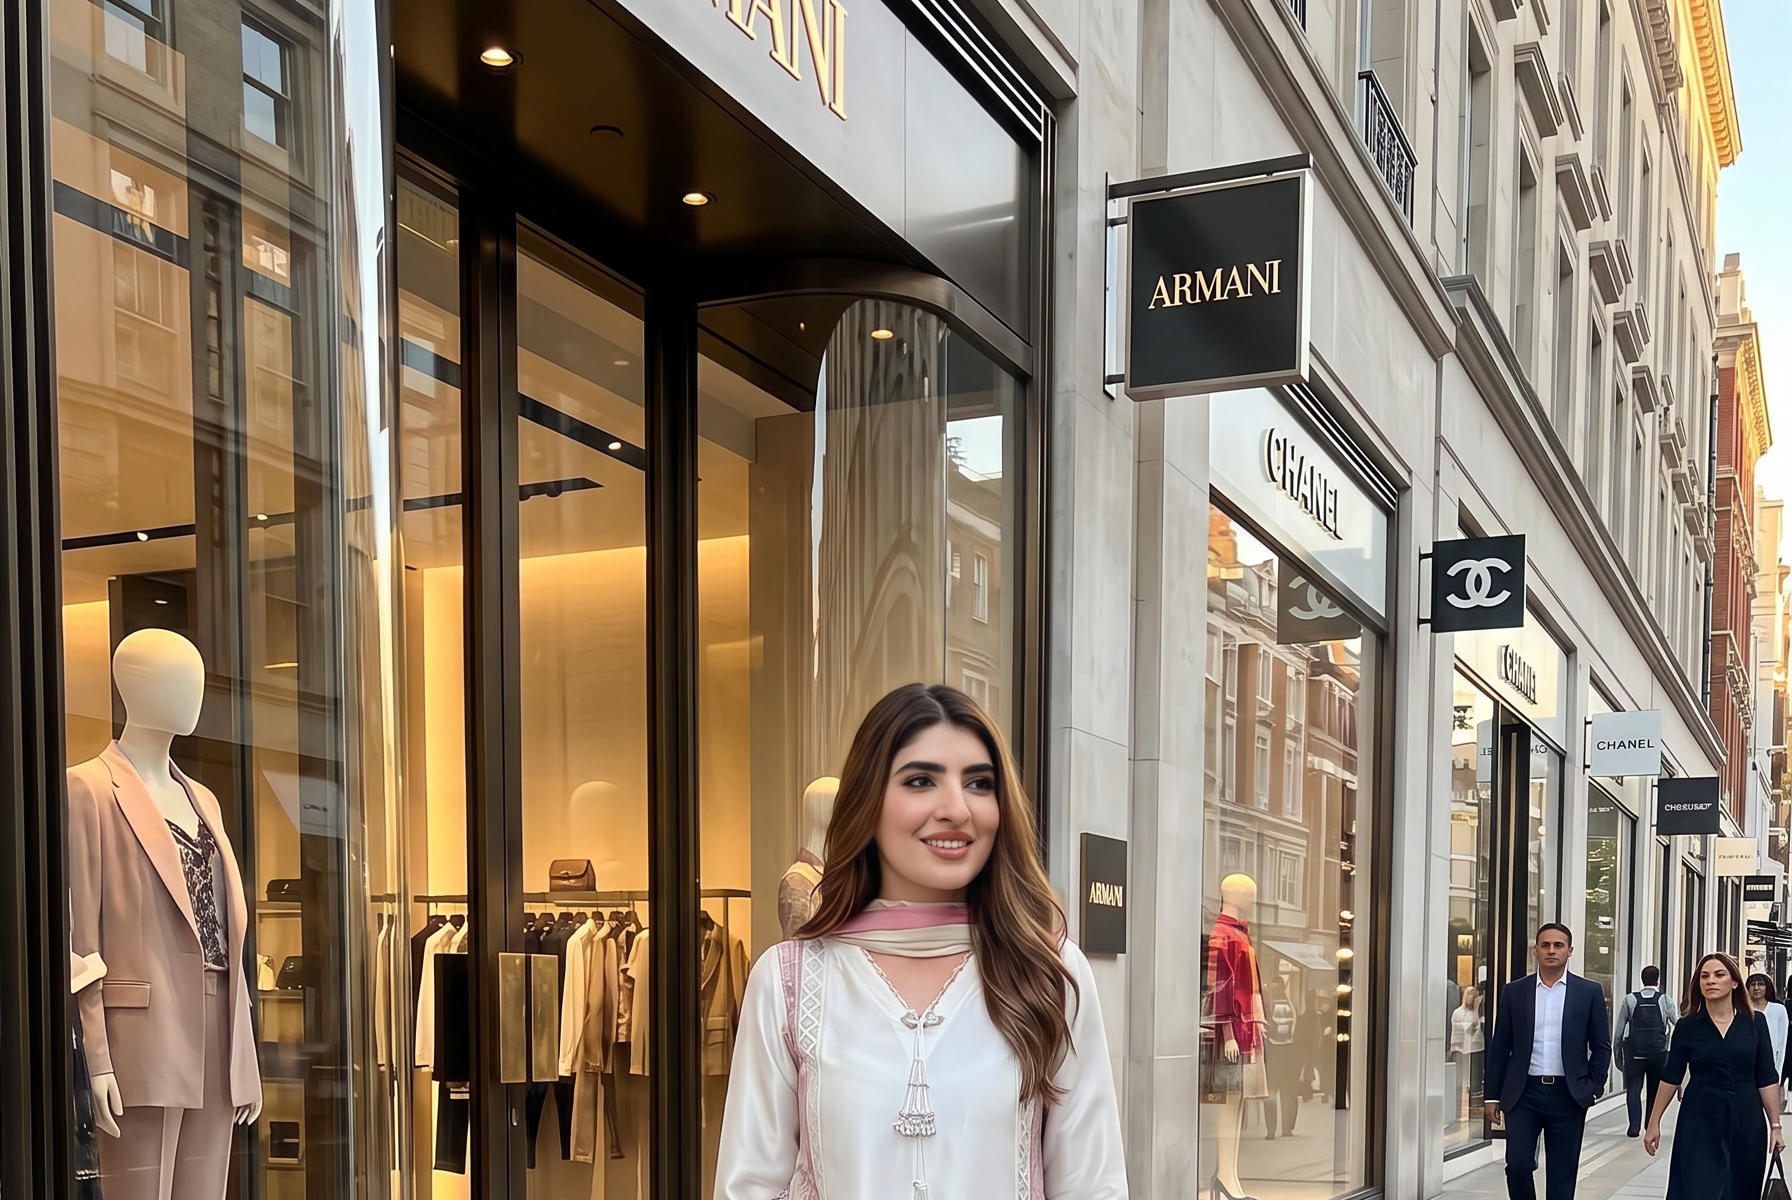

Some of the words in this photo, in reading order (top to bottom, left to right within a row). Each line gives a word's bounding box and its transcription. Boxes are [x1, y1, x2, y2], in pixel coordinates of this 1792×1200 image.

[1148, 259, 1282, 310] ARMANI
[1263, 427, 1343, 541] CHANEL
[1596, 738, 1655, 751] CHANEL
[1088, 881, 1124, 908] ARMANI
